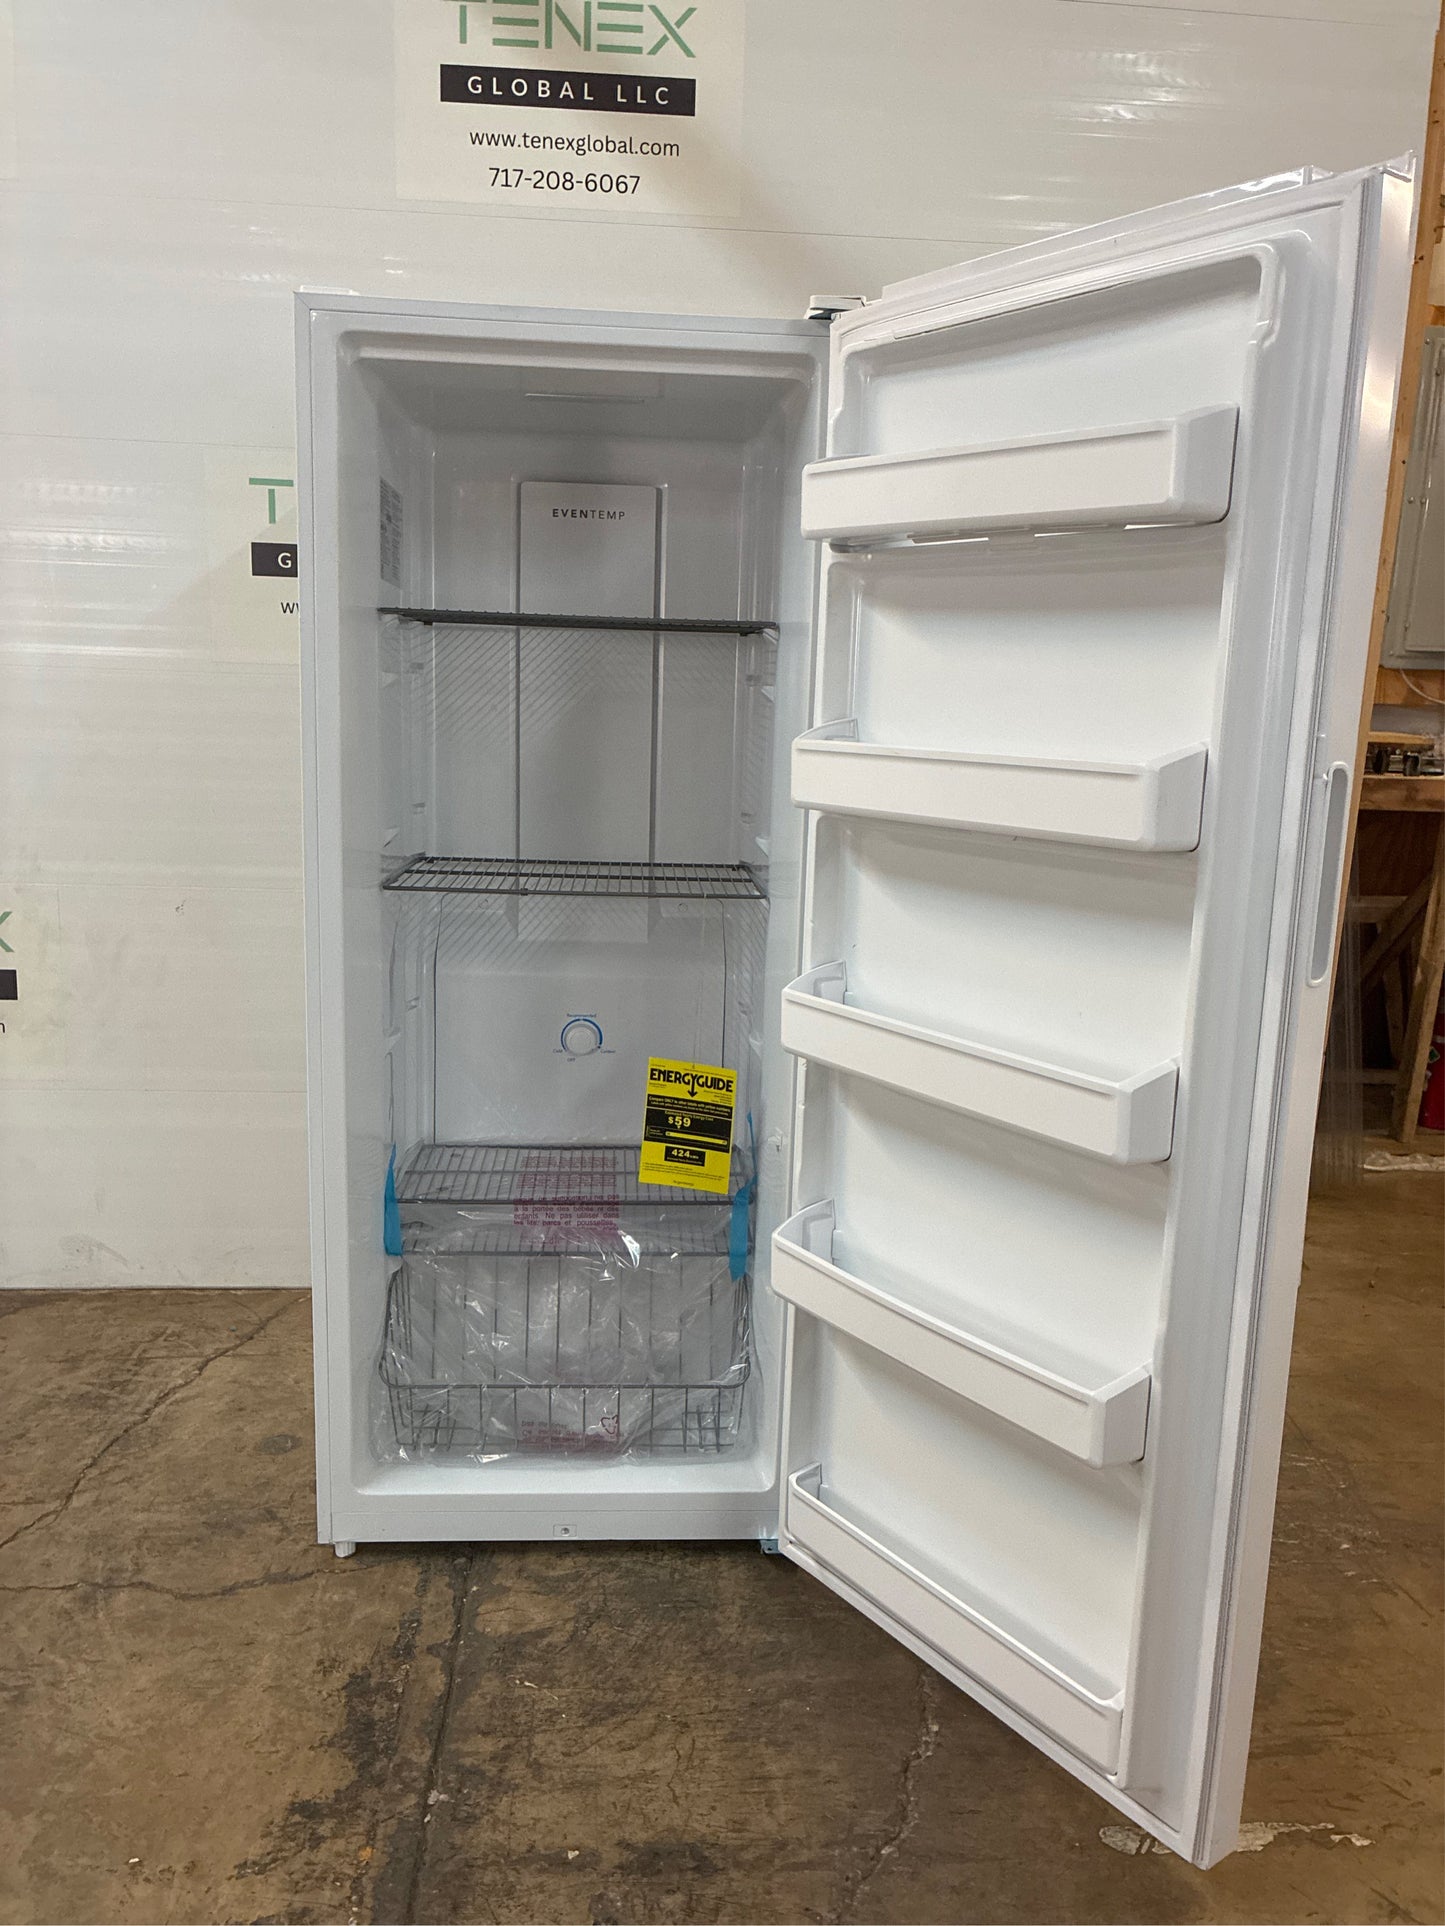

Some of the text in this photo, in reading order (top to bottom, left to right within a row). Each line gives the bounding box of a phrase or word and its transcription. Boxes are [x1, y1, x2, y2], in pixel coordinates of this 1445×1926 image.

[442, 0, 698, 58] TENEX
[467, 75, 669, 105] GLOBAL LLC
[469, 131, 680, 157] www.tenexglobal.com
[488, 167, 641, 195] 717-208-6067
[552, 508, 625, 521] EVENTEMP
[667, 1115, 692, 1127] $59
[671, 1149, 690, 1159] 424
